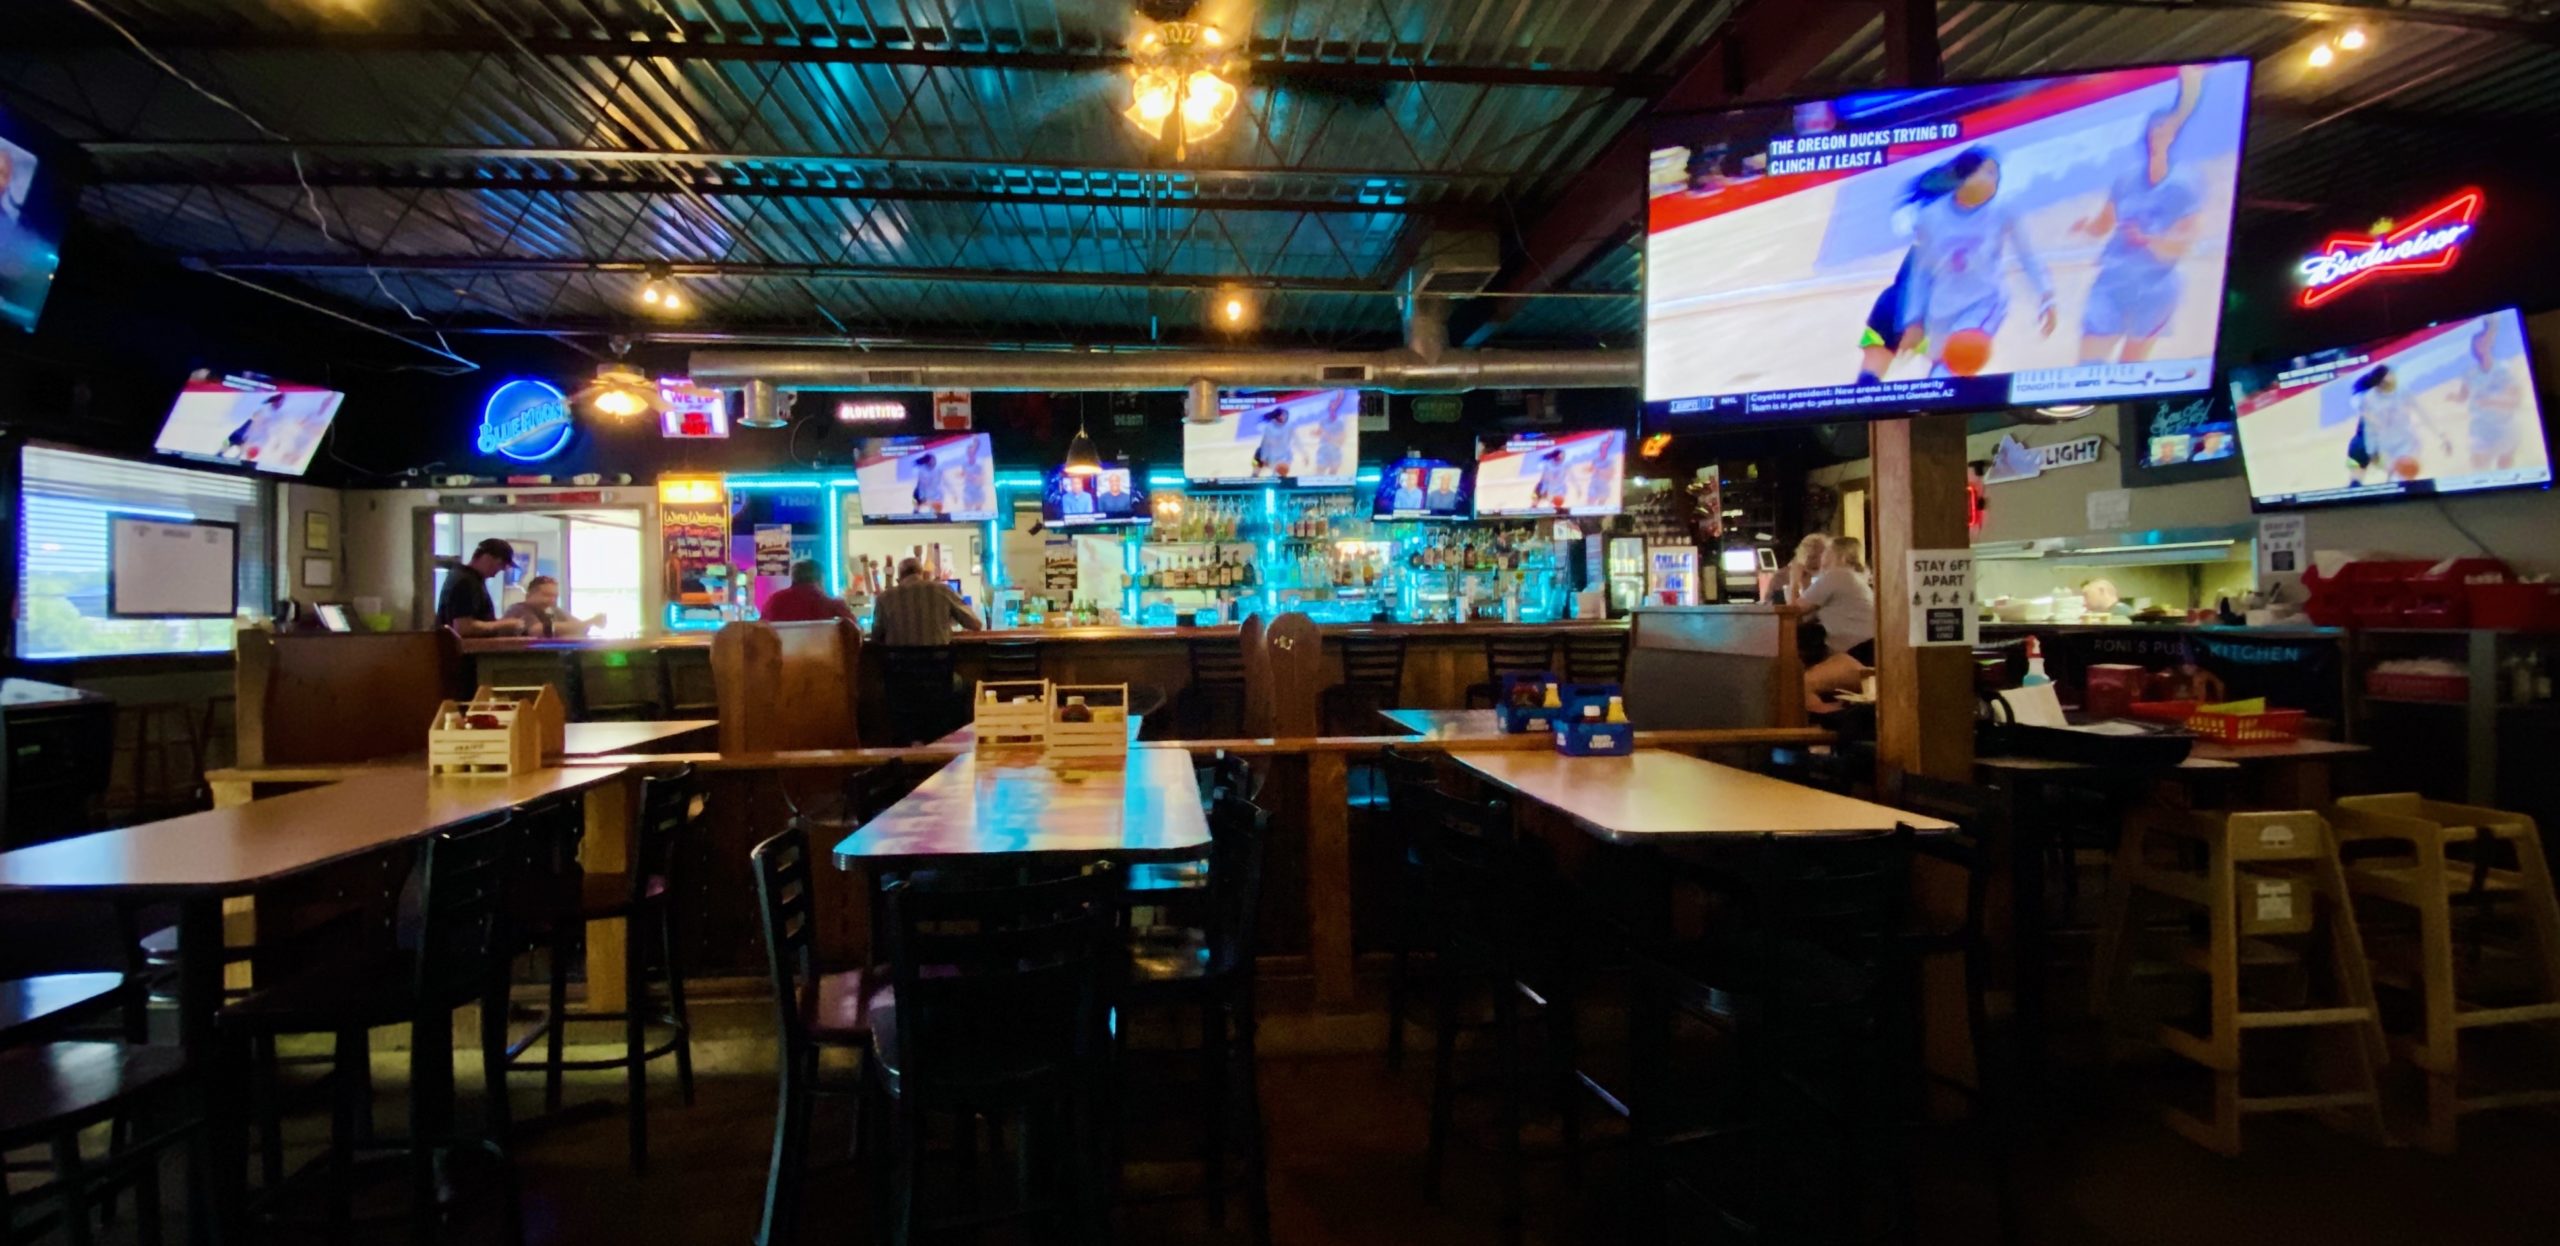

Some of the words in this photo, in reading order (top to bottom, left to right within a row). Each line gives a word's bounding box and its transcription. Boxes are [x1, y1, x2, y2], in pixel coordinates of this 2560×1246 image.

[1771, 140, 1794, 155] THE
[1797, 134, 1847, 152] OREGON
[1850, 130, 1890, 148] DUCKS
[1893, 125, 1938, 143] TRYING
[1941, 123, 1957, 138] TO
[1771, 158, 1815, 174] CLINCH
[1818, 155, 1832, 170] AT
[1835, 152, 1871, 168] LEAST
[1873, 150, 1882, 165] A
[2299, 224, 2469, 286] Budweiser
[1720, 397, 1738, 405] NHL
[1751, 393, 1786, 403] Coyotes
[1788, 389, 1832, 401] president:
[1835, 387, 1855, 395] New
[1856, 385, 1881, 394] arena
[1883, 384, 1891, 392] is
[1893, 383, 1909, 391] top
[1910, 381, 1944, 391] priority
[2016, 382, 2056, 391] TONIGHT
[1751, 402, 1771, 412] Team
[1942, 388, 1954, 398] AZ
[2046, 440, 2099, 464] LIGHT
[1914, 560, 1945, 572] STAY
[1950, 559, 1971, 571] 6FT
[1923, 574, 1965, 586] APART
[2209, 643, 2299, 662] KITCHEN
